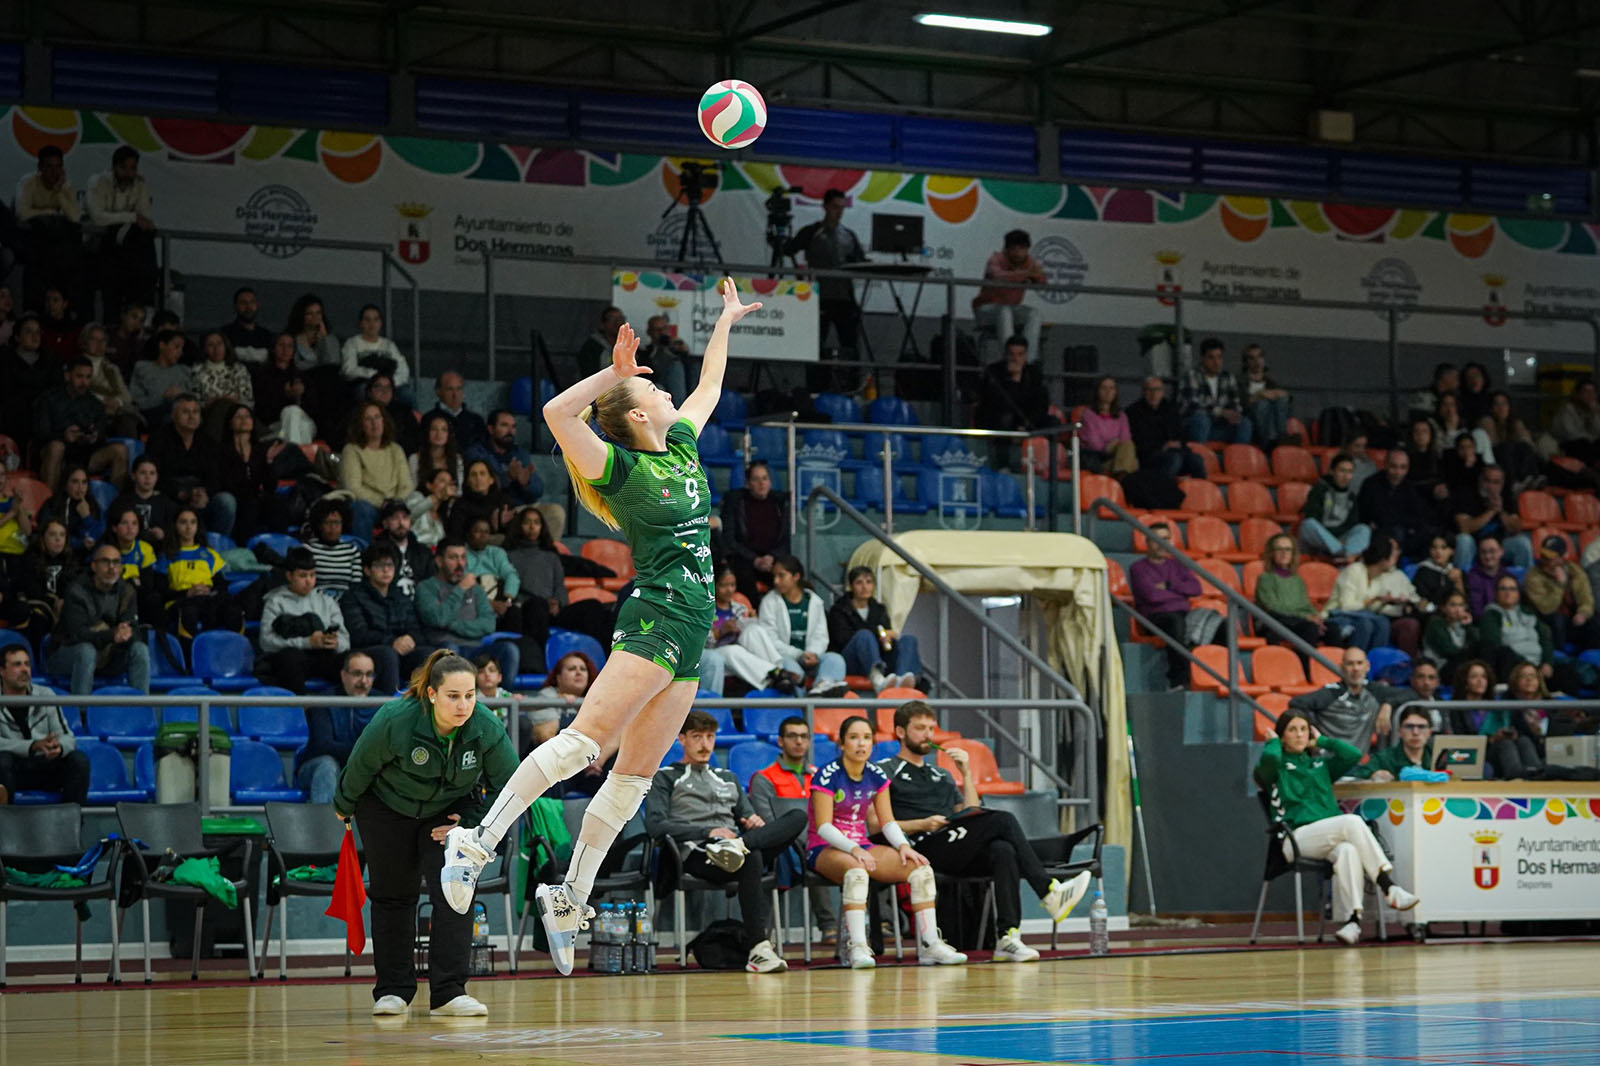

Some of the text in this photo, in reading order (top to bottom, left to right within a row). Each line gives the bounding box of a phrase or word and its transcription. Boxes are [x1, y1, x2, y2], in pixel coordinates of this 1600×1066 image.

[454, 214, 573, 236] Ayuntamiento de
[455, 235, 574, 257] Dos Hermanas
[685, 477, 700, 510] 9
[1518, 859, 1546, 875] Dos
